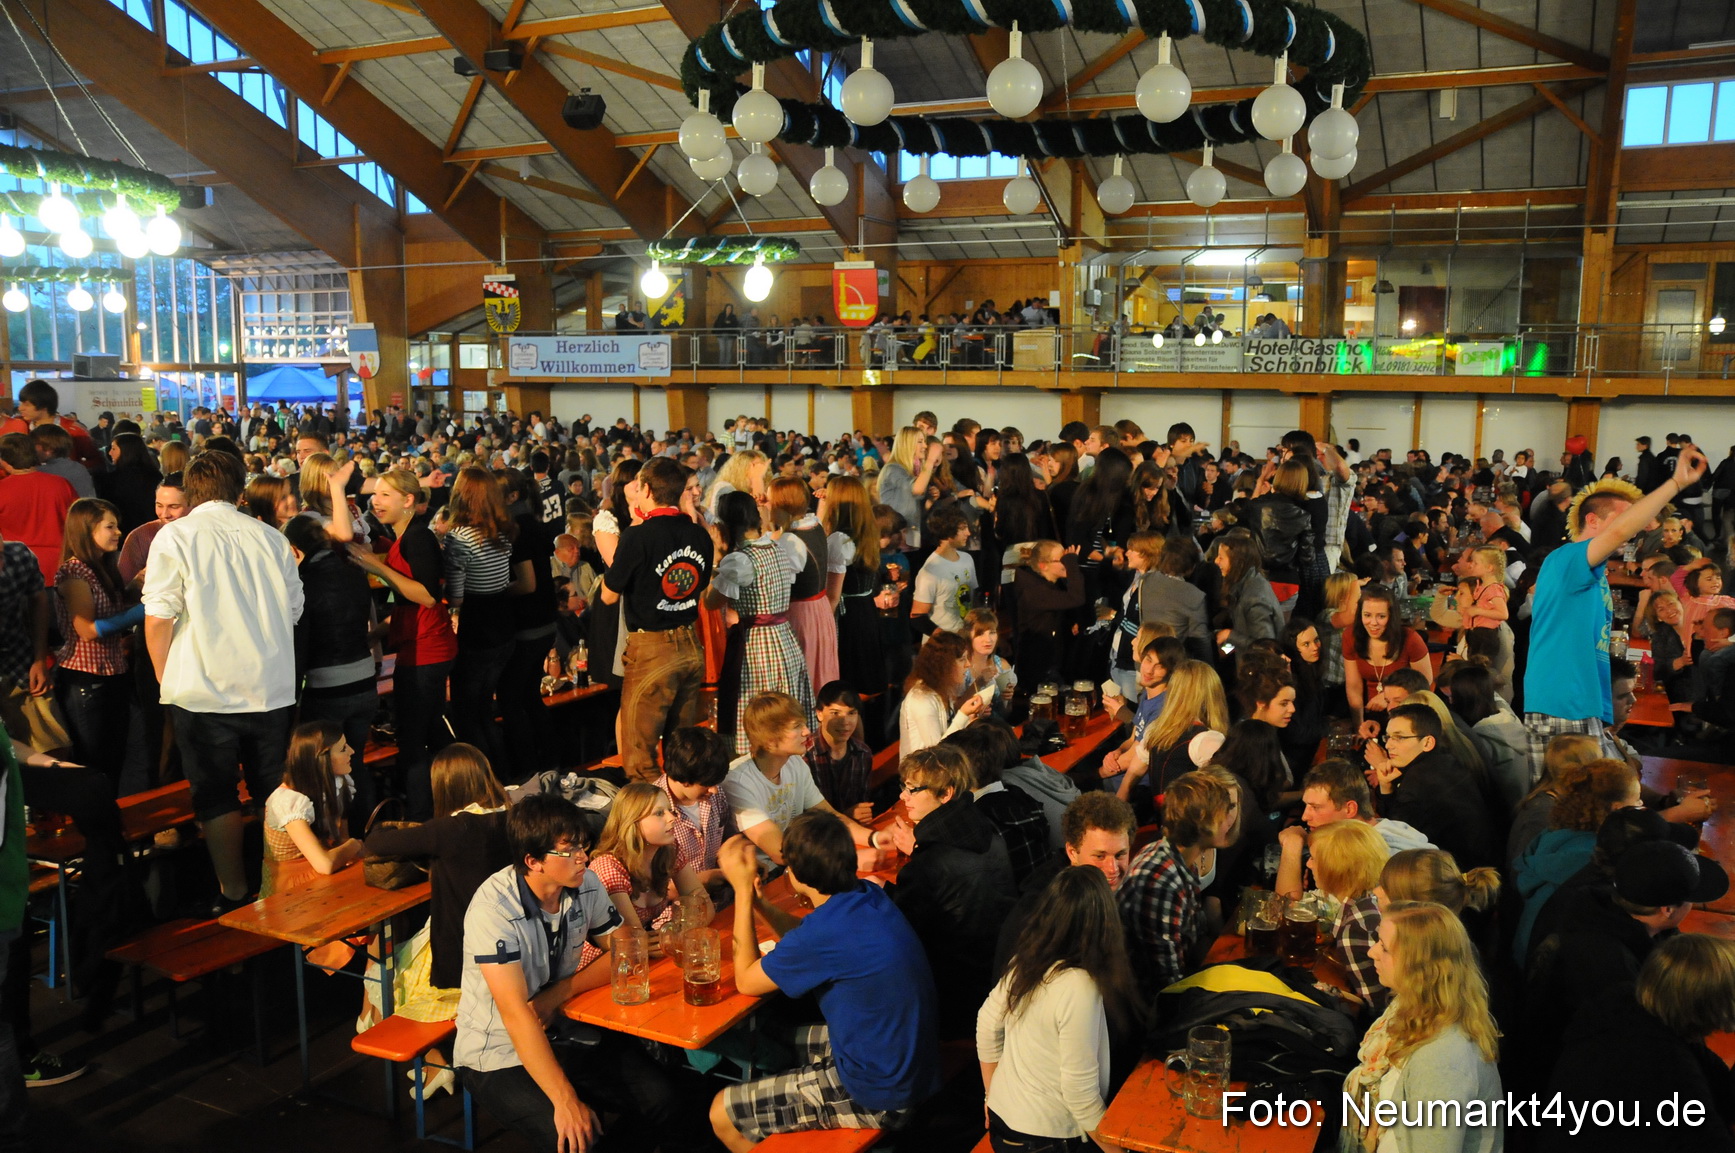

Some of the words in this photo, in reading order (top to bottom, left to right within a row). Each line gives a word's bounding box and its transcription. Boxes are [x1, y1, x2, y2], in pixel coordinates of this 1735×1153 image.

[556, 340, 620, 353] Herzlich
[540, 360, 636, 373] Willkommen
[1250, 357, 1363, 372] Schönblick
[542, 493, 563, 523] 23
